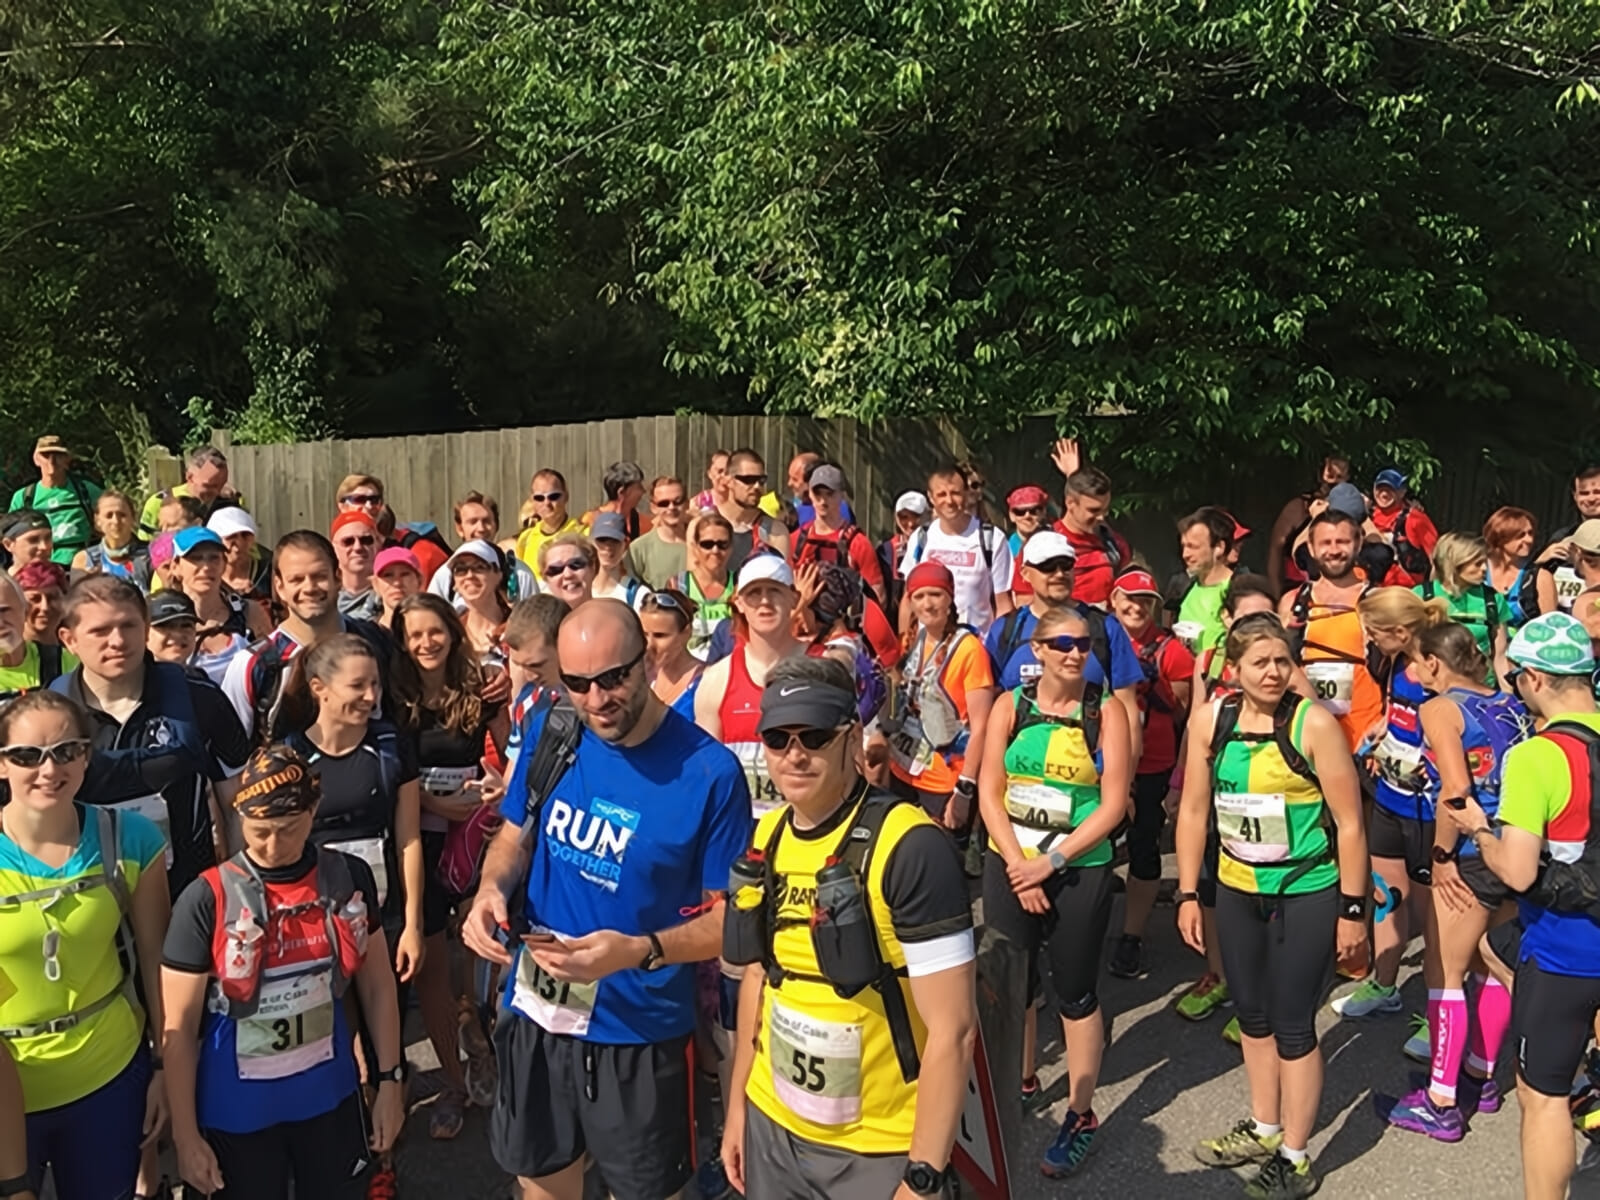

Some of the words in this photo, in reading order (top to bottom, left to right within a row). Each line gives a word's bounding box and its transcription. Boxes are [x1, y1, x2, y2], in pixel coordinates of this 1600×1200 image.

[1316, 679, 1337, 700] 50
[545, 799, 632, 865] RUN
[1240, 816, 1261, 842] 41
[272, 1013, 303, 1051] 31
[792, 1049, 825, 1092] 55
